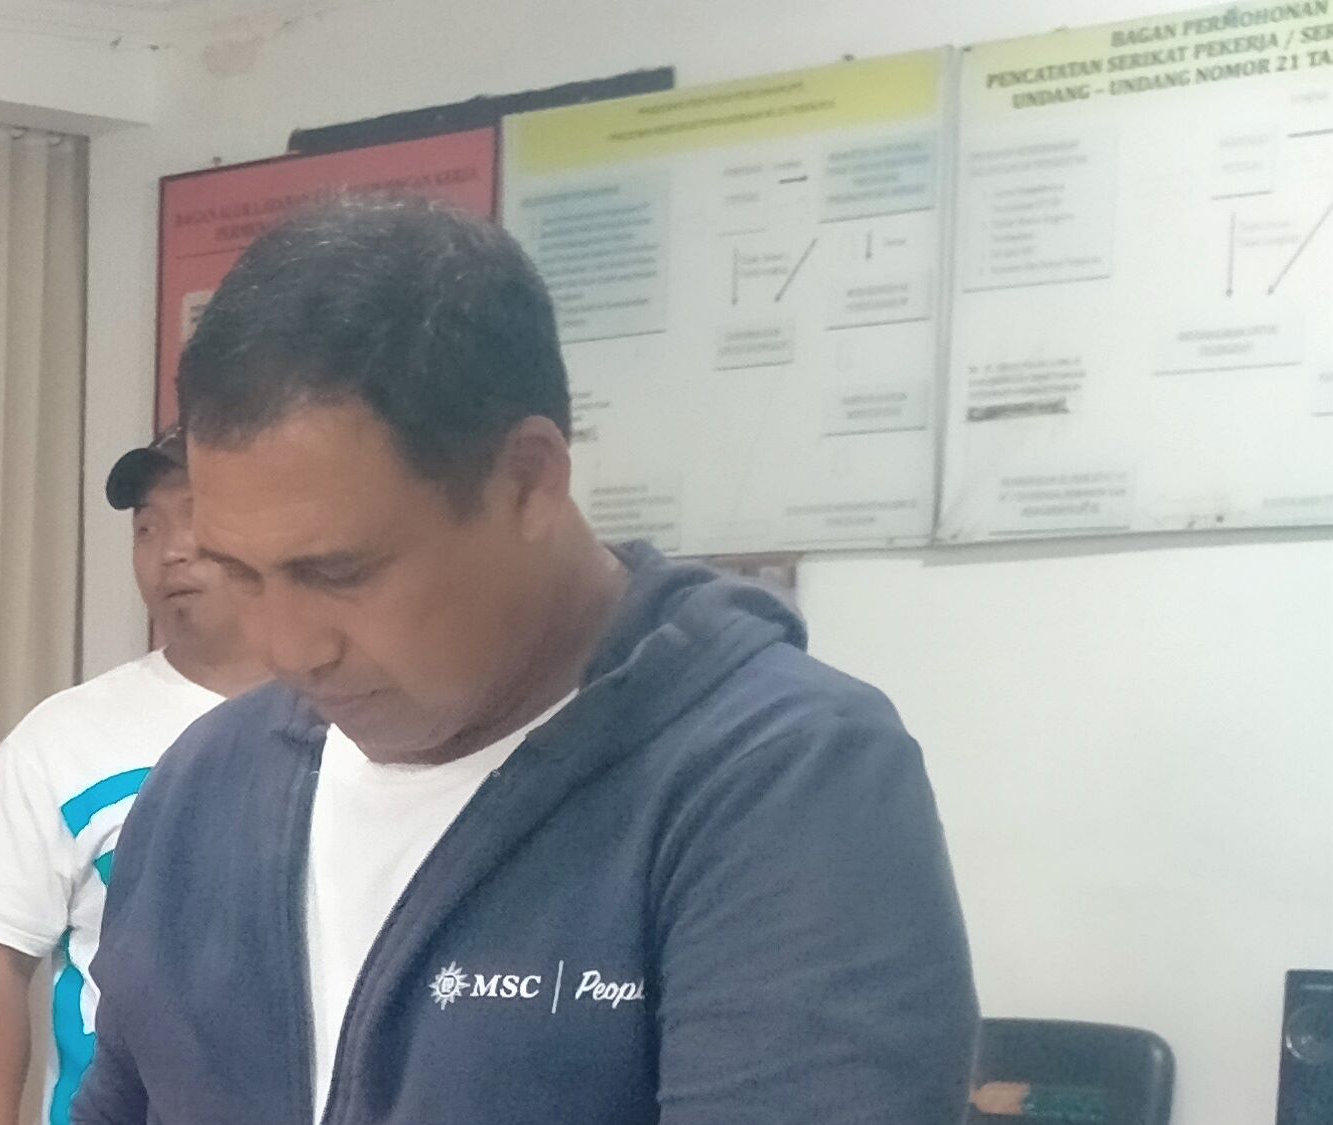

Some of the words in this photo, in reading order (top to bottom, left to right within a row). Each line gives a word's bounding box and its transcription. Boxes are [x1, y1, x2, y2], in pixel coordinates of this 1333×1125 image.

[1111, 24, 1176, 48] BAGAN
[1183, 0, 1329, 36] PERMOHONAN
[986, 61, 1103, 89] PENCATATAN
[1107, 46, 1188, 73] SERIKAT
[1194, 32, 1279, 59] PEKERJA
[1012, 85, 1090, 109] UNDANG
[1109, 70, 1190, 95] UNDANG
[1195, 57, 1270, 81] NOMOR
[1275, 53, 1299, 72] 21
[470, 974, 542, 998] MSC
